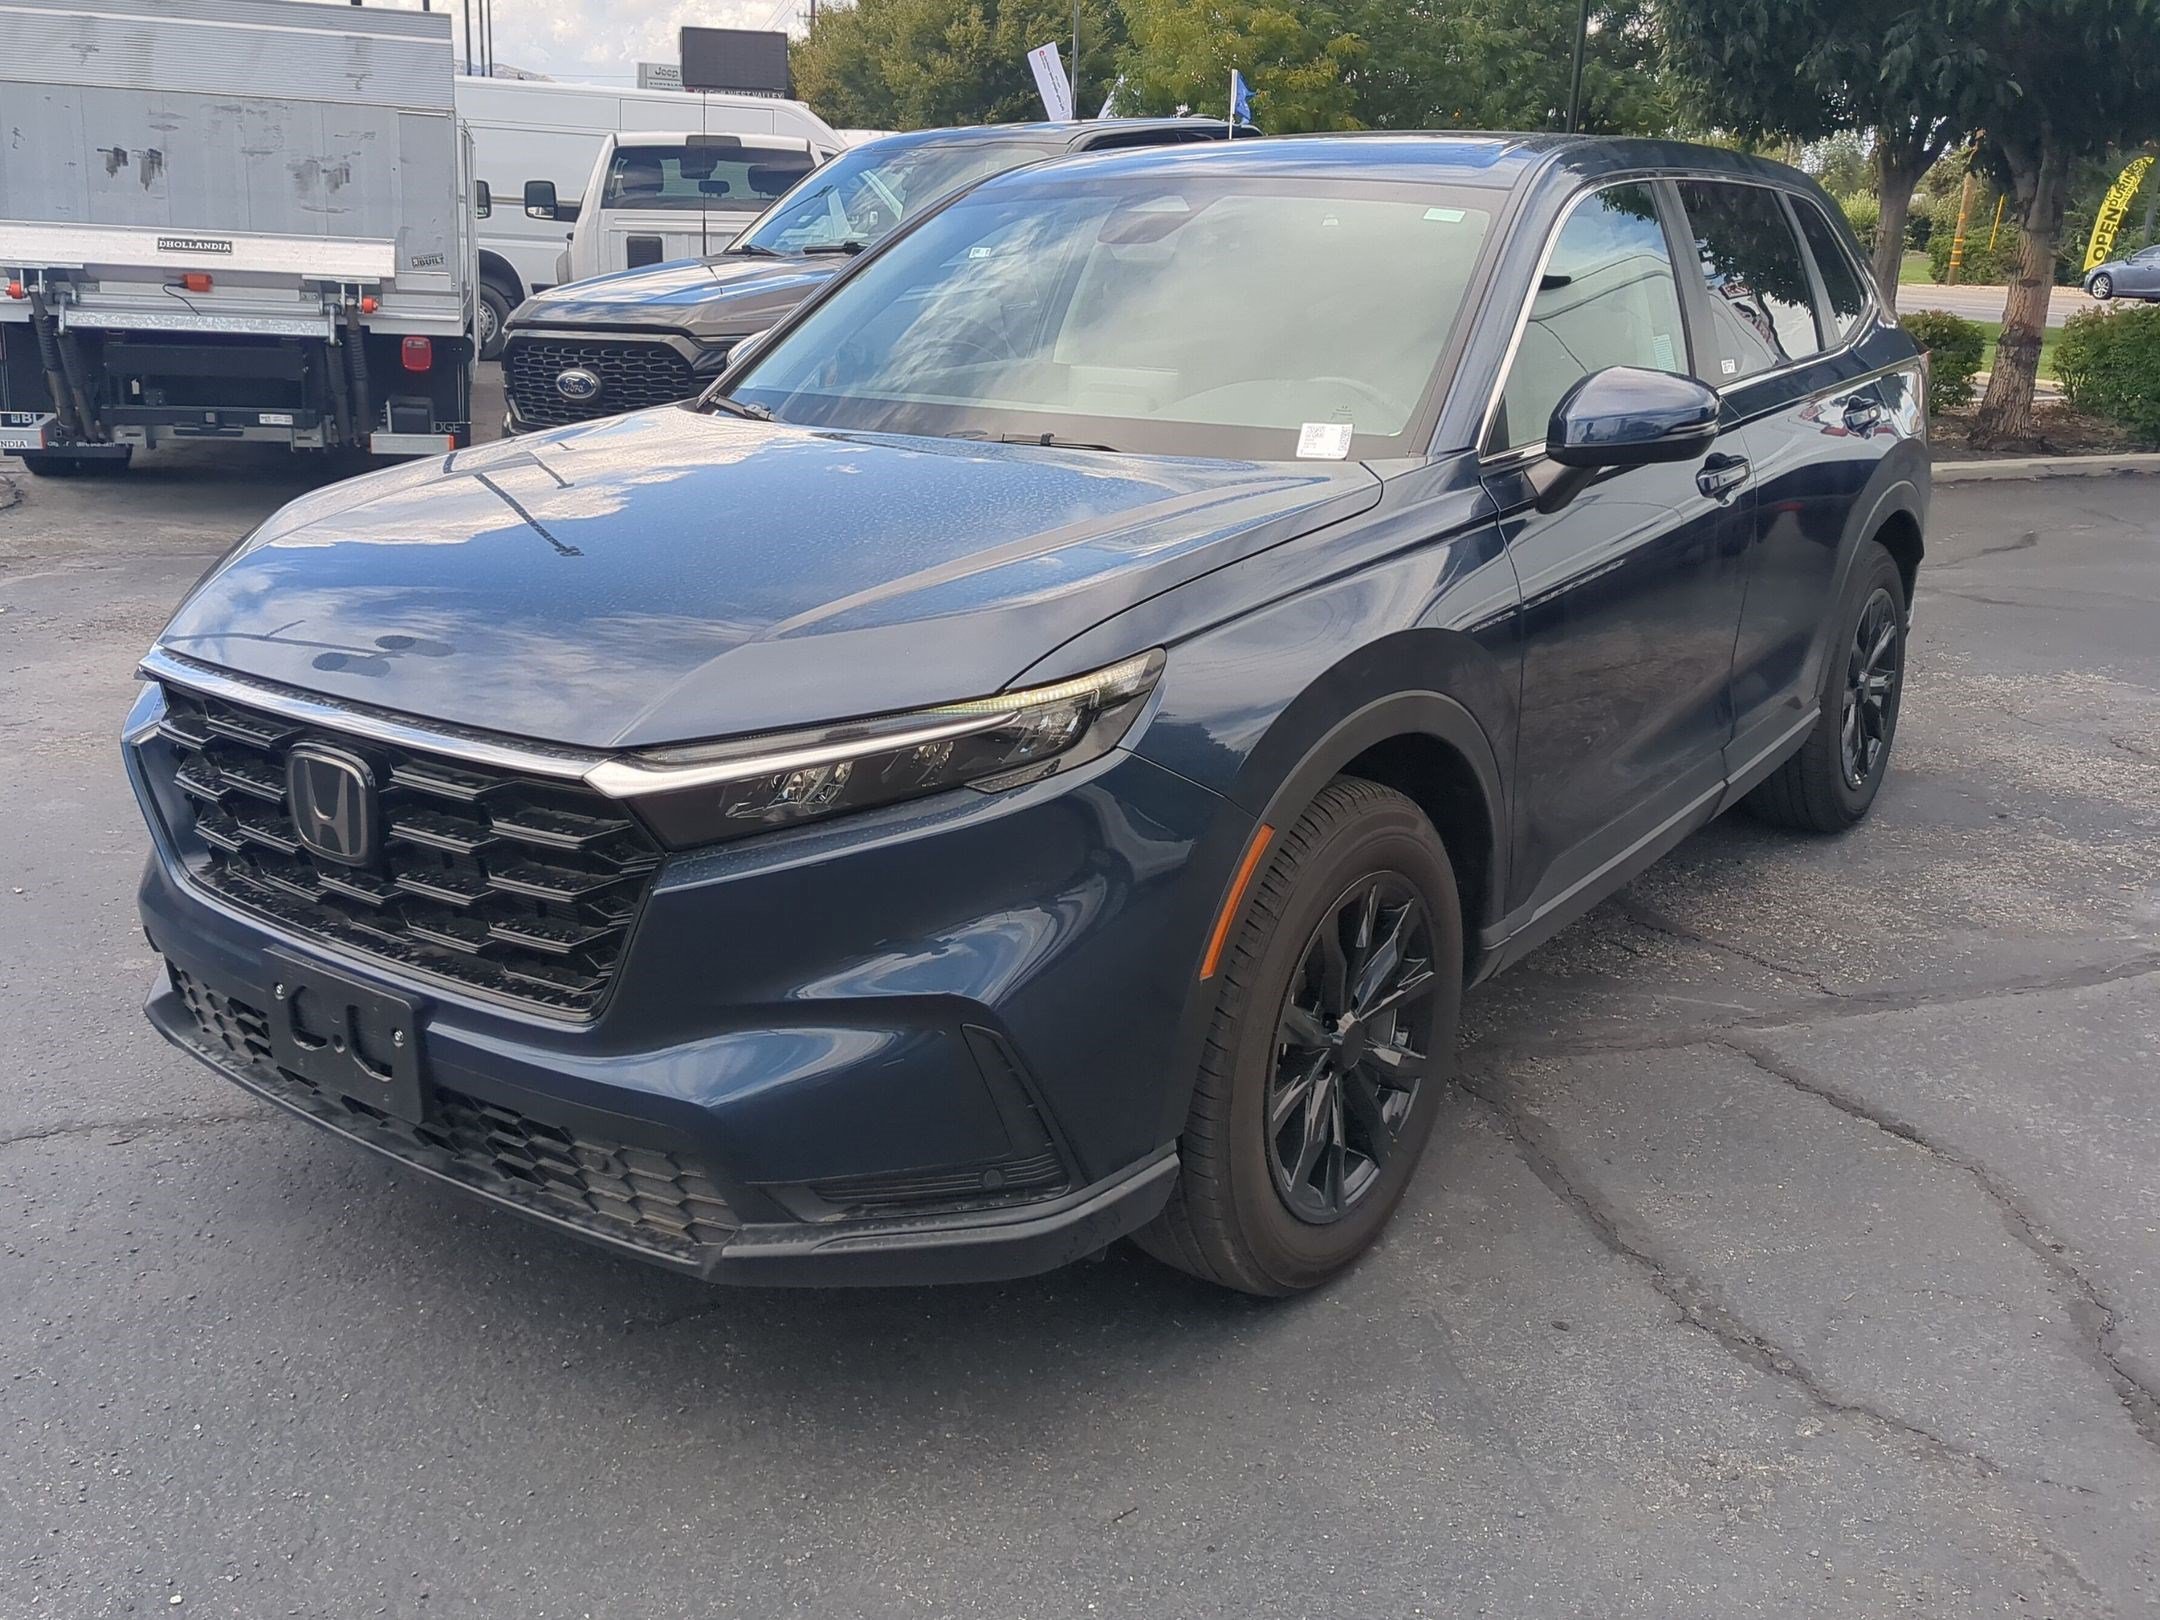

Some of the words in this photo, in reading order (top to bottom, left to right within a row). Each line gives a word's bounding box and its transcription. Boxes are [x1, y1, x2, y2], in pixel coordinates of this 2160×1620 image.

[654, 66, 679, 78] Jeep
[2092, 207, 2121, 262] OPEN
[159, 239, 231, 251] DHOLLANDIA
